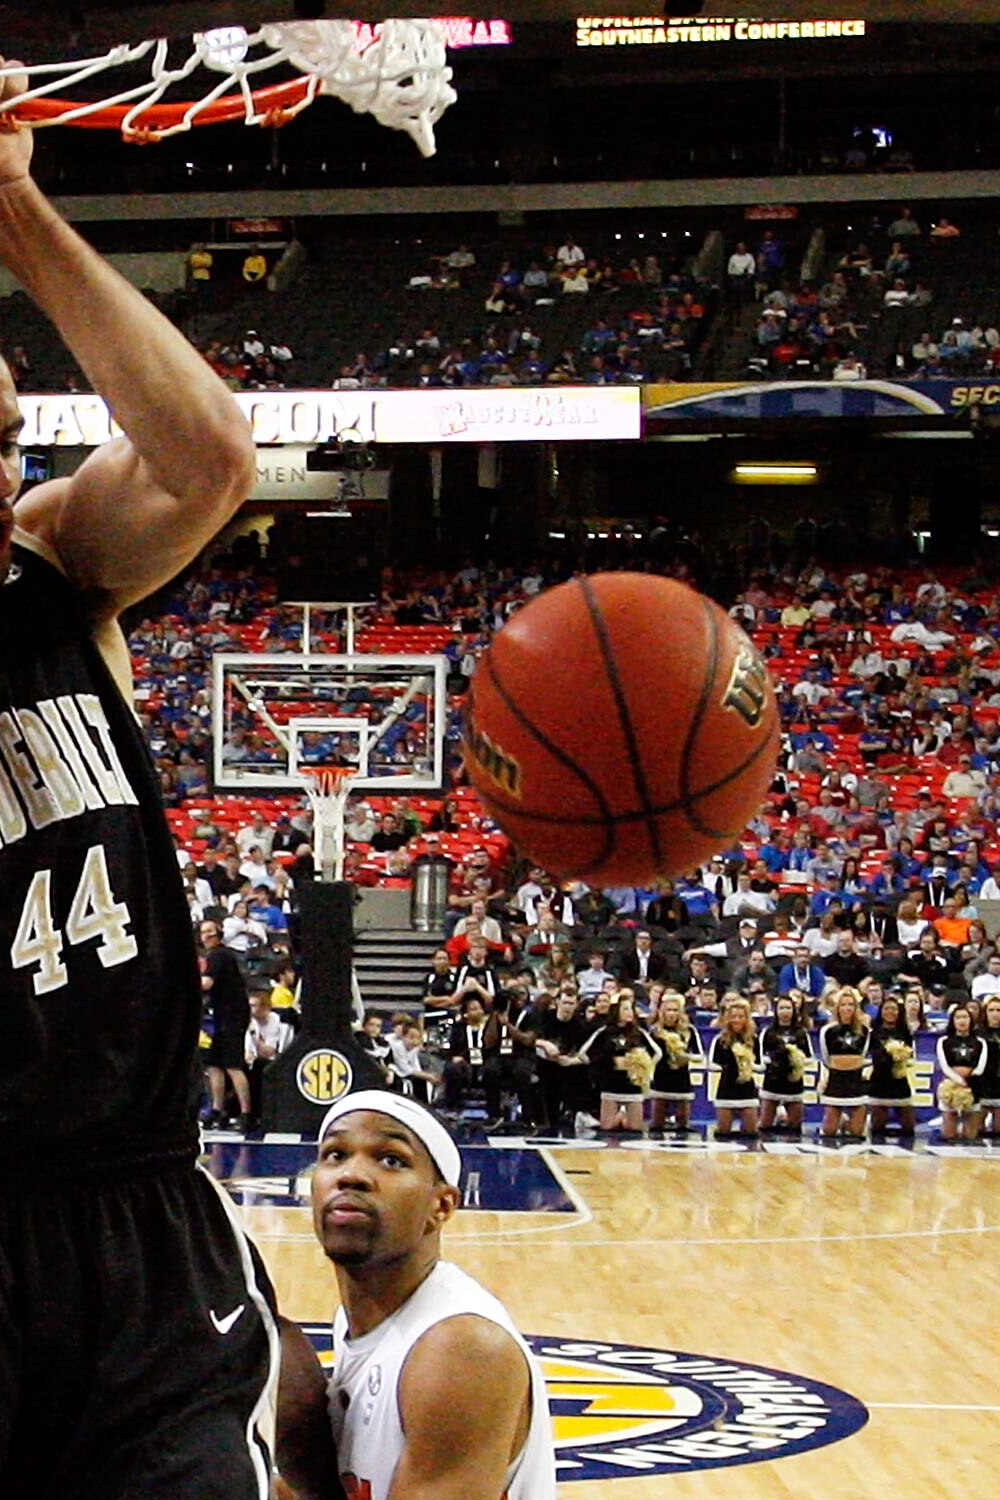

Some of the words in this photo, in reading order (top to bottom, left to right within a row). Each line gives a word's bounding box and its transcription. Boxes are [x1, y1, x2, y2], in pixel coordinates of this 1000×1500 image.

[576, 25, 731, 46] SOUTHEASTERN
[734, 20, 866, 40] CONFERENCE
[10, 844, 138, 996] 44
[301, 1053, 348, 1100] SEC
[541, 1343, 831, 1469] SOUTHEASTERN
